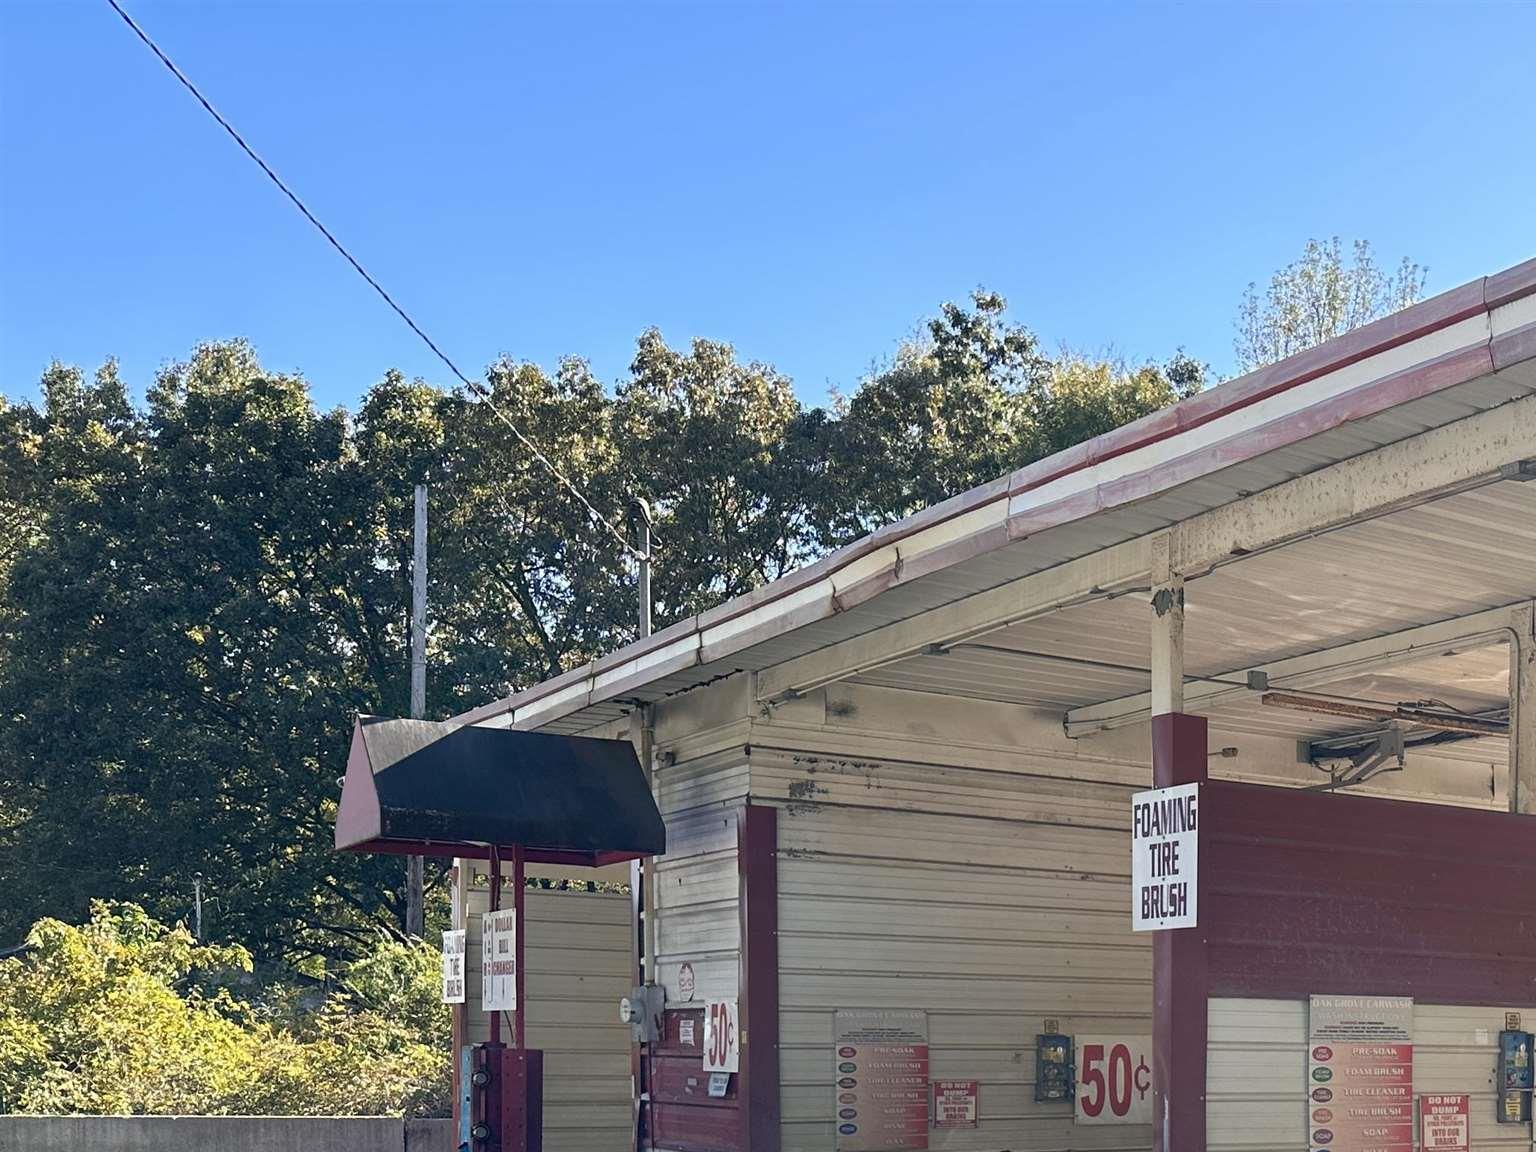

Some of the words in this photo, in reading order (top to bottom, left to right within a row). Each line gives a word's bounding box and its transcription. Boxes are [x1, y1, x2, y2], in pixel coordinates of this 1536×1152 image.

[1134, 795, 1197, 839] FOAMING
[1149, 841, 1180, 877] TIRE
[1141, 883, 1188, 920] BRUSH
[1428, 1096, 1441, 1104] DO
[1443, 1096, 1461, 1104] NOT
[1432, 1106, 1459, 1114] DUMP
